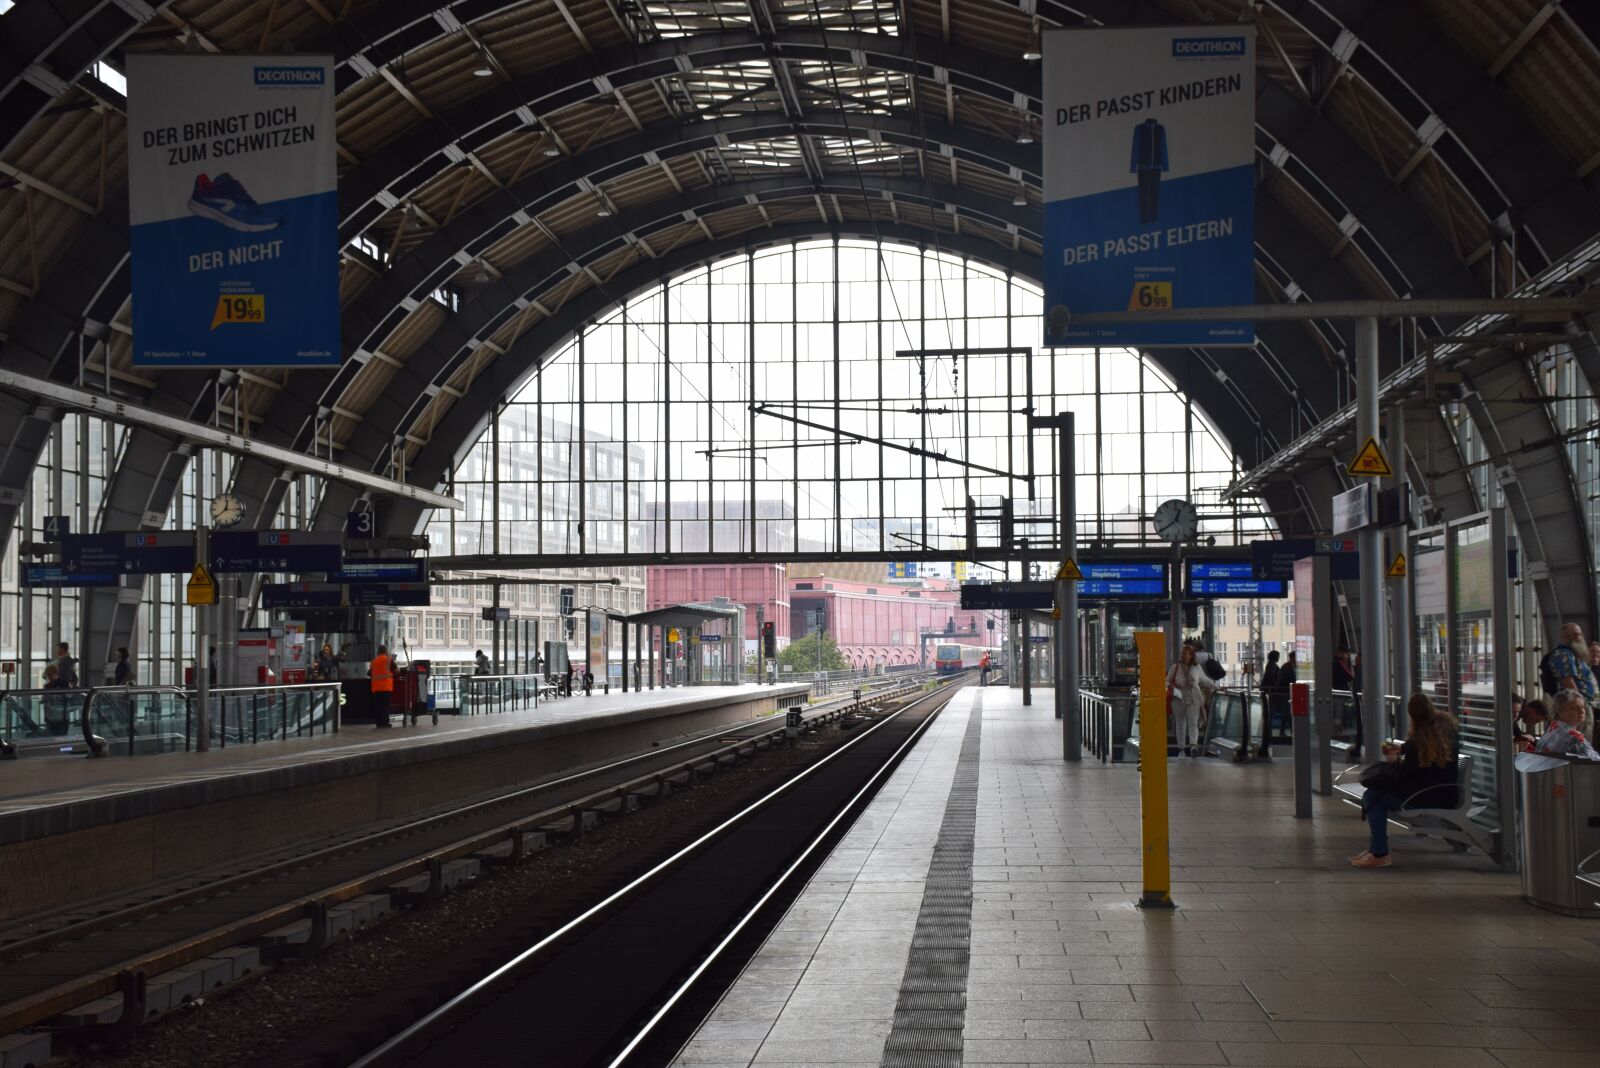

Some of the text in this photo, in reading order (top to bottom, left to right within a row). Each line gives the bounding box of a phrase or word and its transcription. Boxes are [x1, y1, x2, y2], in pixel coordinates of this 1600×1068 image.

[1176, 41, 1242, 53] DECATHLON
[257, 70, 321, 82] DECATHLON
[1056, 74, 1241, 126] DER PASST KINDERN
[143, 106, 296, 148] DER BRINGT DICH
[168, 125, 315, 166] ZUM SCHWITZEN
[1063, 217, 1233, 266] DER PASST ELTERN
[189, 240, 283, 272] DER NICHT
[1139, 285, 1153, 307] 6
[223, 298, 247, 319] 19
[46, 516, 60, 536] 4
[357, 511, 371, 532] 3
[270, 535, 278, 544] U
[1321, 540, 1342, 551] S U
